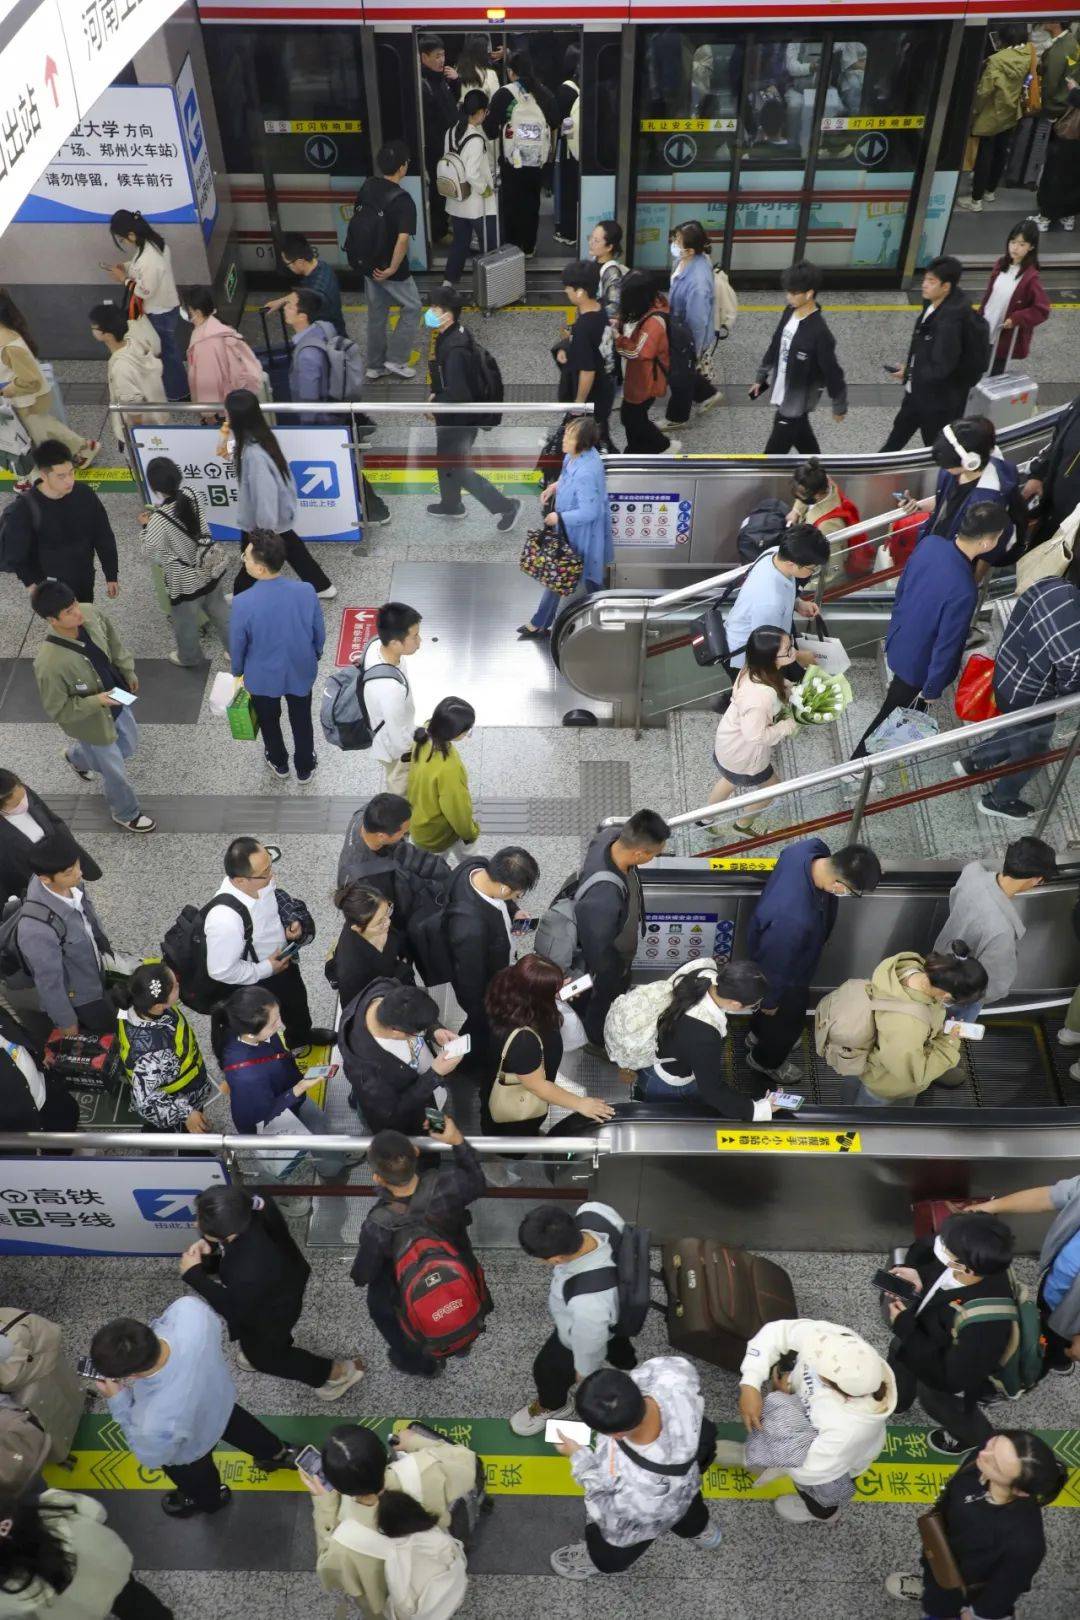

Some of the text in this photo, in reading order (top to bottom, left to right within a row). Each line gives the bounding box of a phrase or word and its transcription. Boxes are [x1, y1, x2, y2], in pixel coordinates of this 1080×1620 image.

[82, 0, 143, 61] 河南工
[123, 123, 153, 138] 方向
[640, 120, 706, 131] 礼让安全行
[176, 463, 204, 479] 坐
[28, 1188, 105, 1206] 高铁
[431, 1298, 464, 1322] SPORT
[706, 1468, 755, 1493] 高铁
